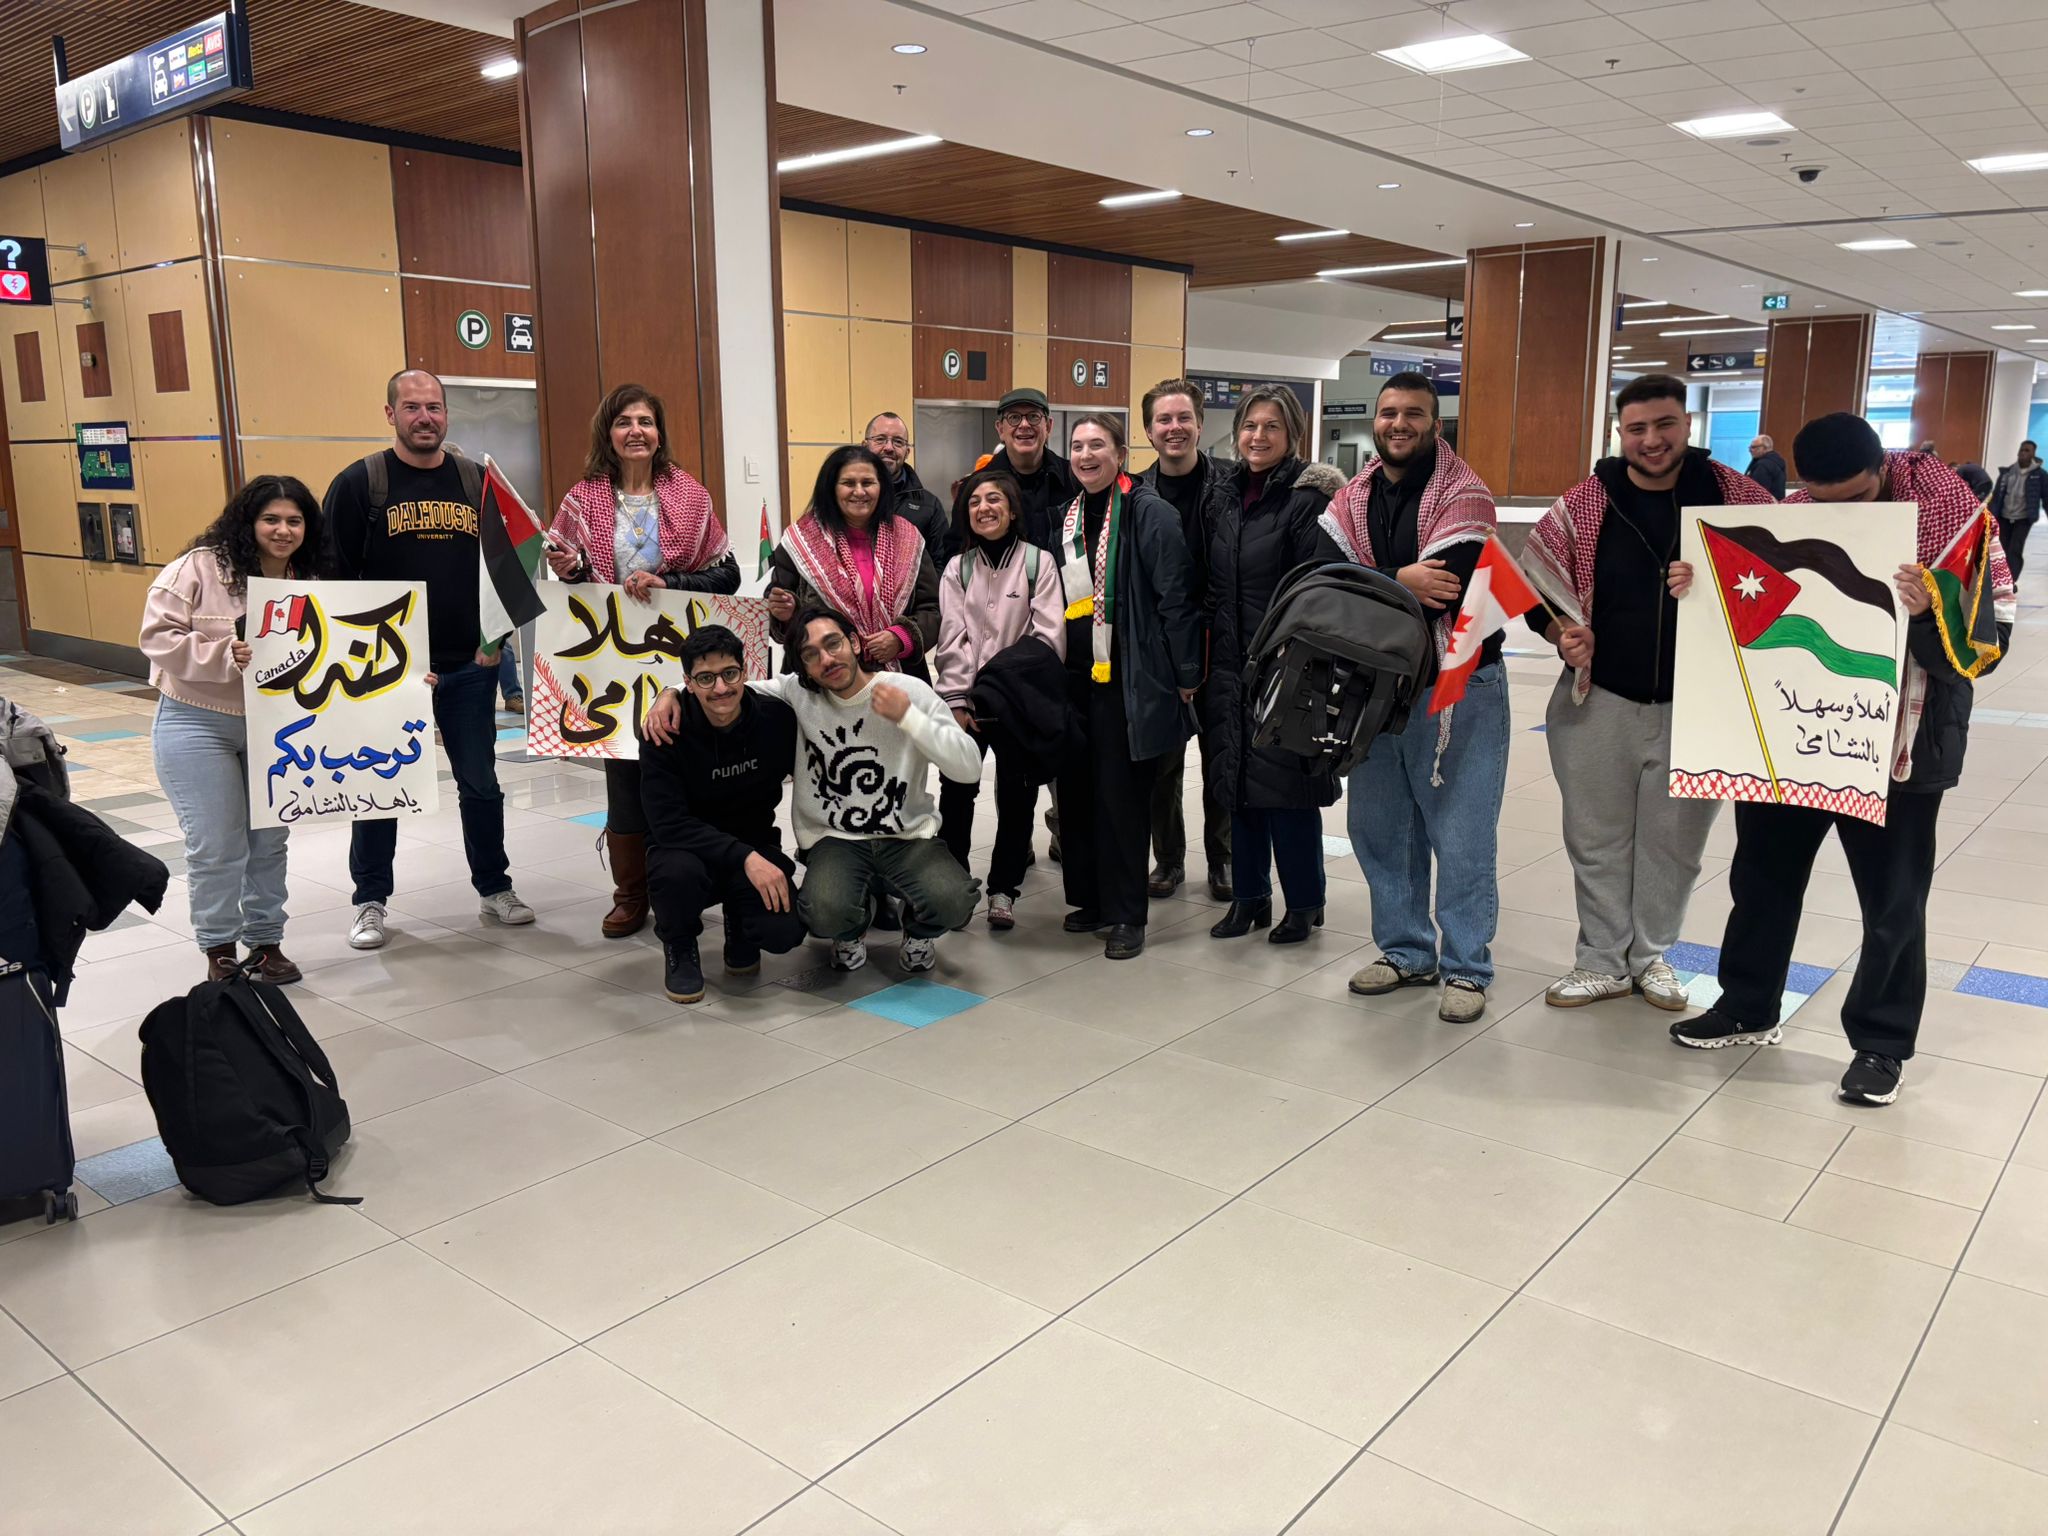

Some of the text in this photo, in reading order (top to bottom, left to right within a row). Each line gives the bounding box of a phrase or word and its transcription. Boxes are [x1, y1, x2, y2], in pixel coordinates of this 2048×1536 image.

[83, 93, 92, 121] P
[467, 317, 484, 342] P
[948, 355, 958, 373] P
[1076, 364, 1085, 383] P
[387, 501, 479, 538] DALHOUSIE
[254, 648, 308, 683] Canada
[257, 590, 417, 712] كندا
[267, 713, 427, 808] ترحب بكم
